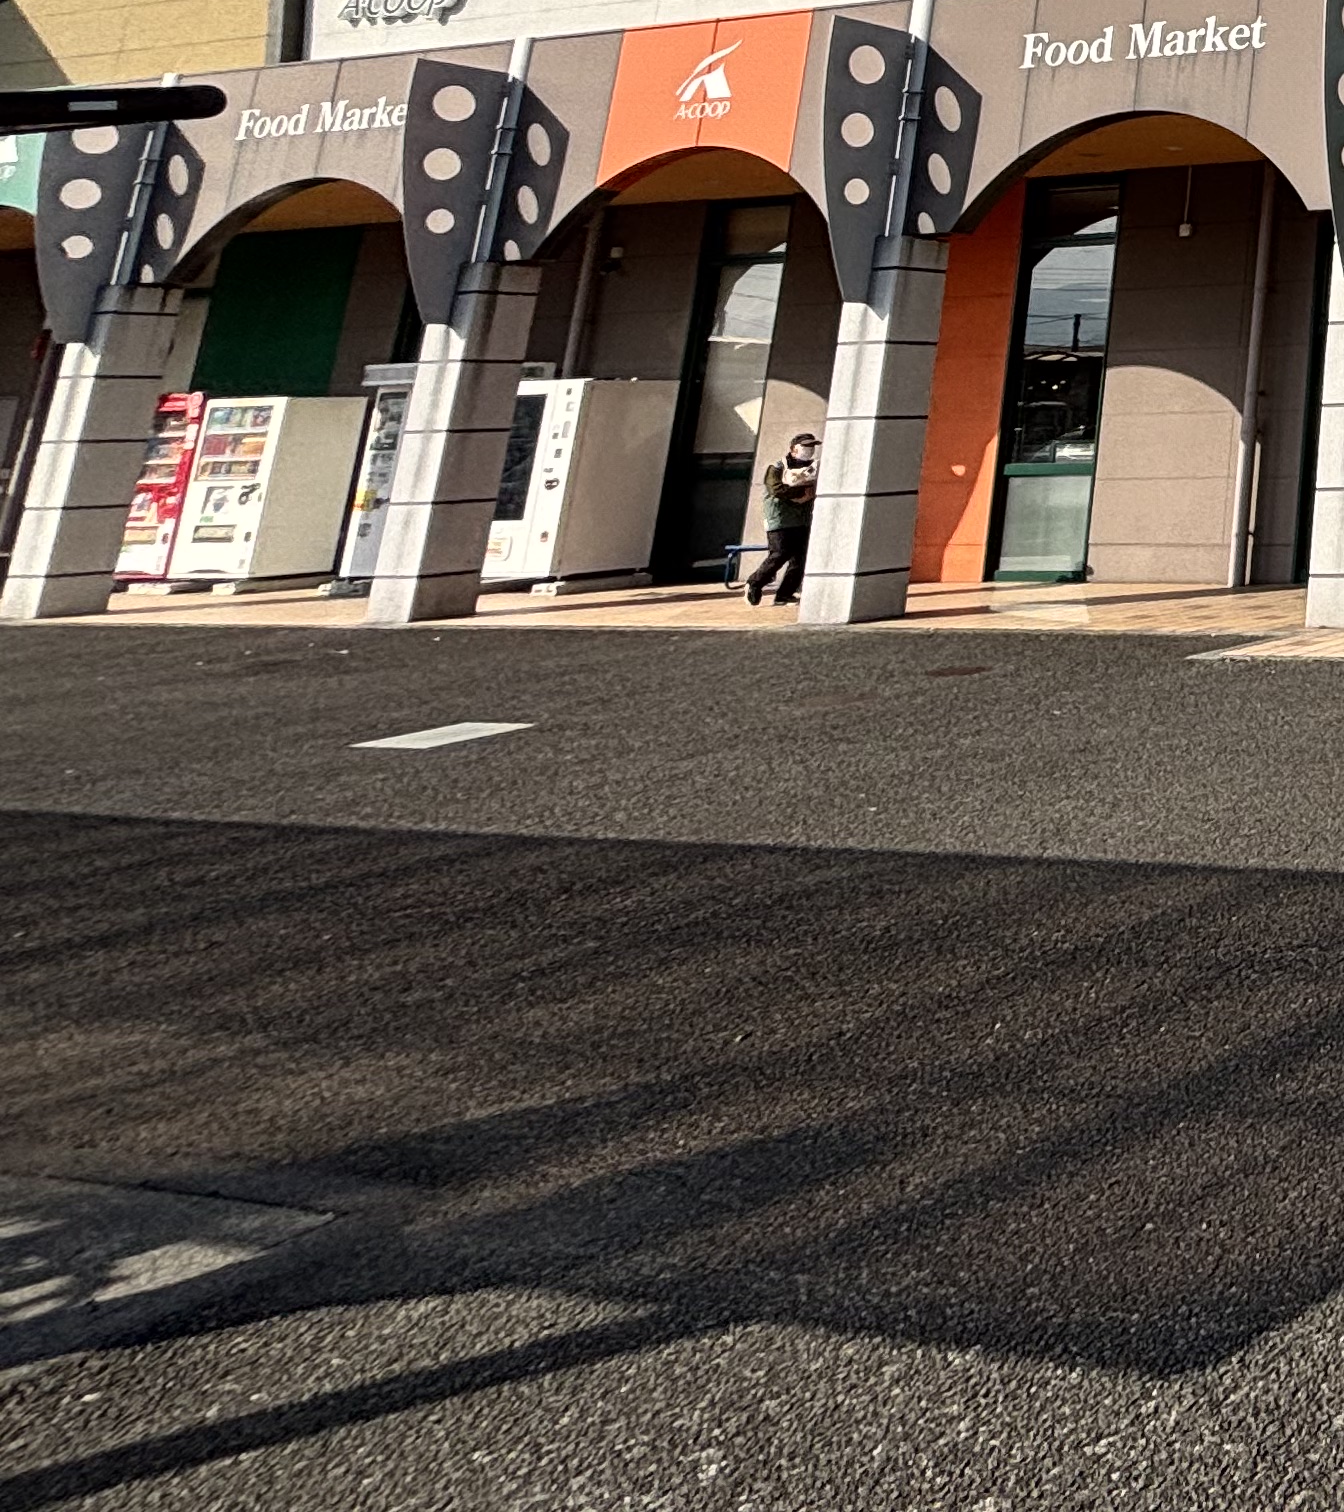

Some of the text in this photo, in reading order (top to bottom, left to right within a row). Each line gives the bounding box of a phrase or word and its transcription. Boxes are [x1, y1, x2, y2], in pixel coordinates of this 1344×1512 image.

[1018, 15, 1267, 69] Food Market
[234, 95, 408, 141] Food Marke
